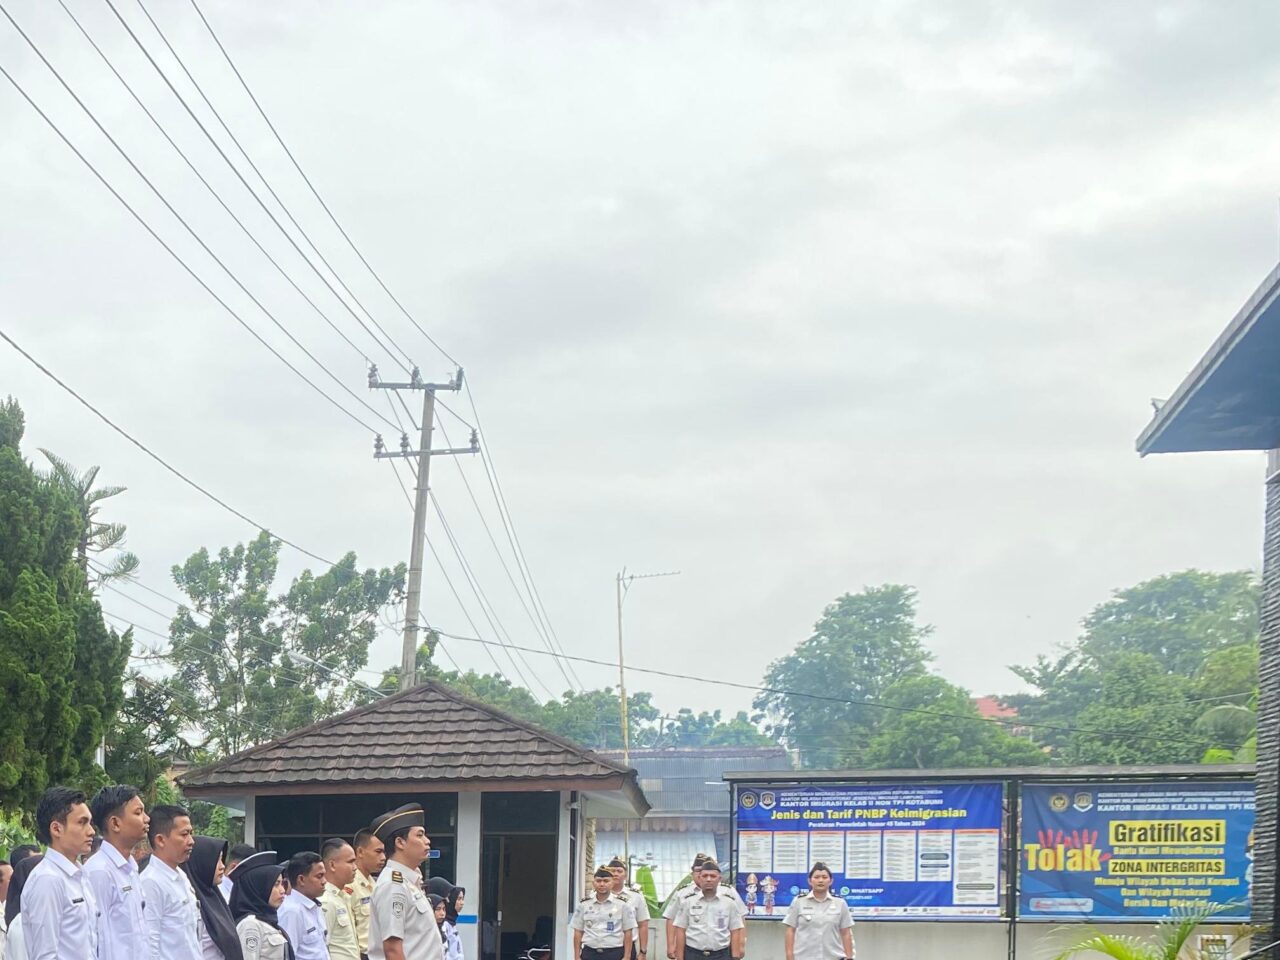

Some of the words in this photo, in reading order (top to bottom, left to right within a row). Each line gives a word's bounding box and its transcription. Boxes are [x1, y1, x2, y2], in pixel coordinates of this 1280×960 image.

[771, 810, 800, 820] Jenis
[803, 810, 824, 819] dan
[827, 809, 853, 819] Tarif
[855, 809, 887, 819] PNBP
[890, 807, 967, 819] Keimigrasian
[1114, 823, 1221, 842] Gratifikasi
[1024, 843, 1102, 871] Tolak
[1111, 862, 1142, 873] ZONA
[1146, 861, 1221, 873] INTERGRITAS
